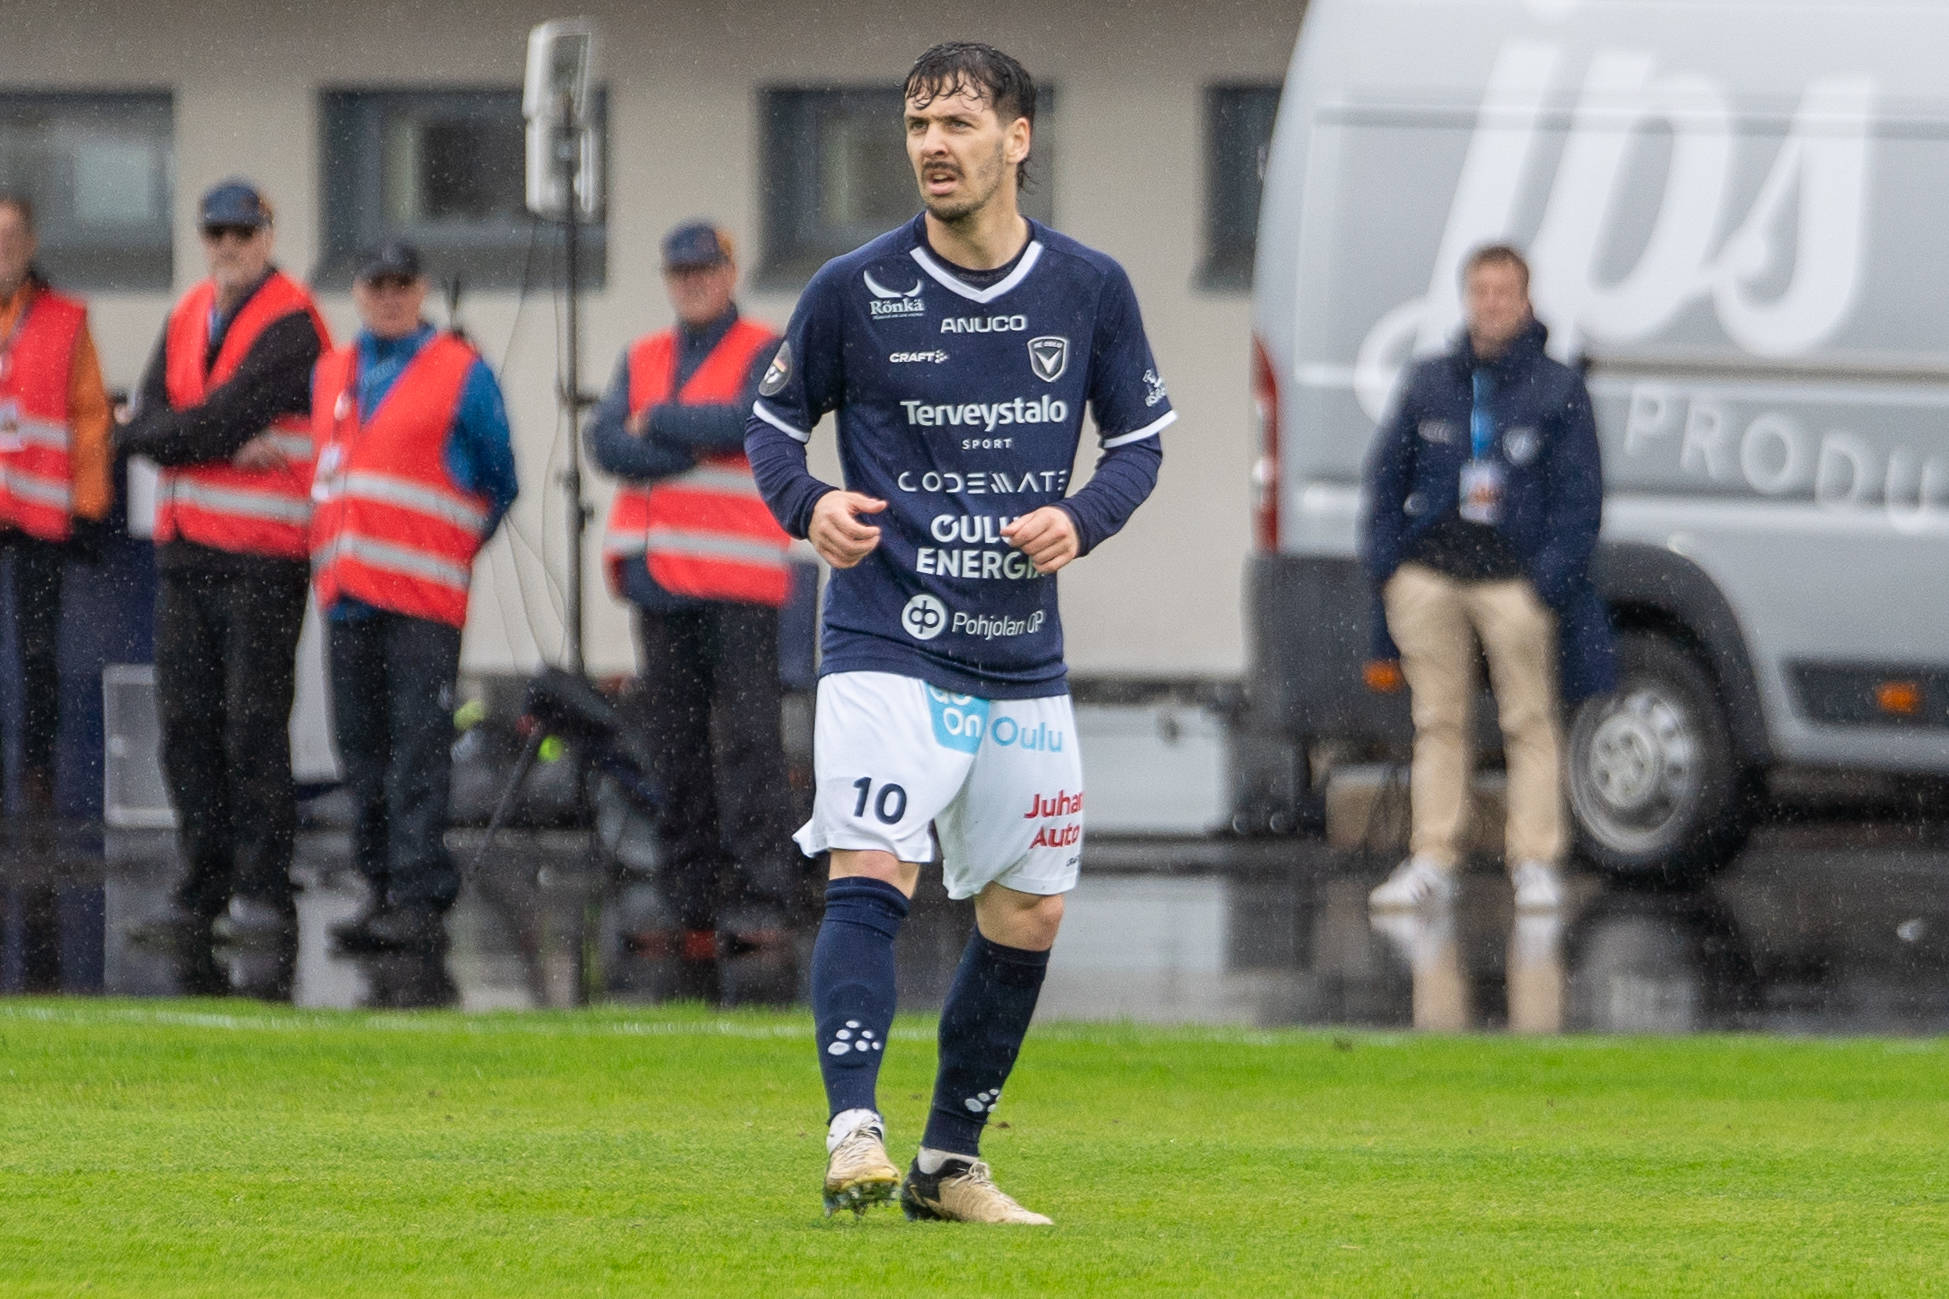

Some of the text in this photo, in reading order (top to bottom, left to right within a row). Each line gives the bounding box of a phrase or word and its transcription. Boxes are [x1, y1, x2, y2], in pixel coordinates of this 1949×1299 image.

[869, 298, 924, 315] Rönkä
[940, 315, 1027, 333] ANUCO
[889, 352, 935, 363] CRAFT
[900, 394, 1068, 431] Terveystalo
[962, 438, 1012, 450] SPORT
[897, 470, 1068, 494] CODEMATE
[916, 548, 1045, 580] ENERGI
[951, 612, 1025, 641] Pohjolan
[943, 707, 1063, 752] On Oulu
[853, 776, 908, 825] 10
[1028, 822, 1080, 849] Auto
